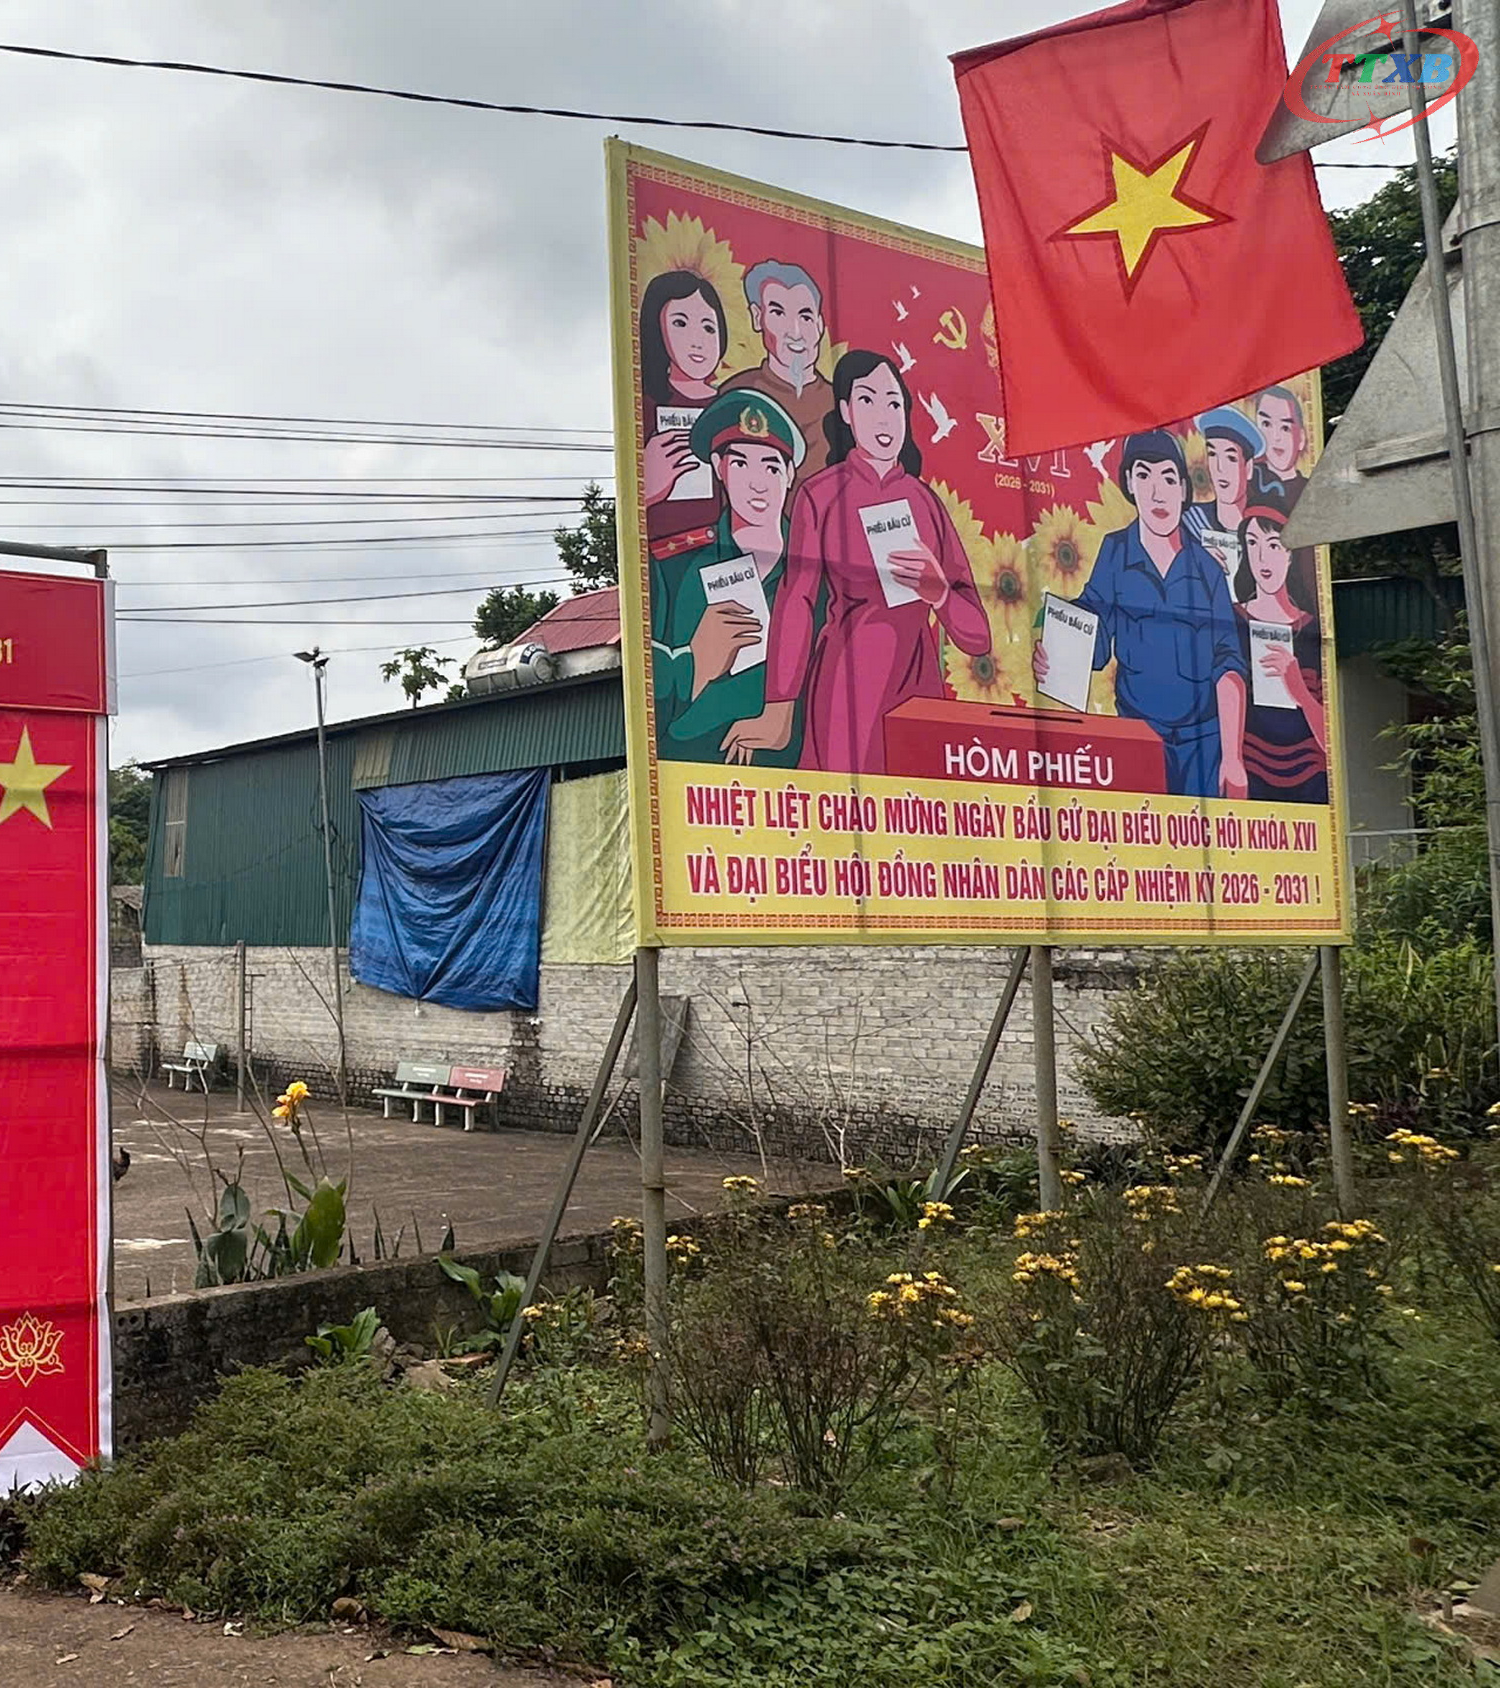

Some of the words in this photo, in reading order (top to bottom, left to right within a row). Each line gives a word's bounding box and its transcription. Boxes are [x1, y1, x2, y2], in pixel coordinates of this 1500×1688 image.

[945, 737, 1019, 779] HÒM
[1027, 744, 1114, 787] PHIẾU
[686, 780, 757, 836] NHIỆT
[764, 783, 812, 838] LIỆT
[818, 787, 878, 833] CHÀO
[884, 791, 948, 836] MỪNG
[953, 795, 1006, 839] NGÀY
[1012, 794, 1052, 842] BẦU
[1057, 797, 1084, 842] CỬ
[1087, 809, 1117, 850] ĐẠI
[1122, 800, 1162, 845] BIỂU
[1167, 804, 1211, 850] QUỐC
[1215, 811, 1243, 856] HỘI
[1248, 813, 1290, 852] KHÓA
[1292, 821, 1318, 852] XVI
[686, 846, 721, 894] VÀ
[727, 856, 768, 903] ĐẠI
[775, 843, 827, 895] BIỂU
[834, 853, 872, 905] HỘI
[878, 849, 937, 898] ĐỒNG
[943, 857, 1000, 899] NHÂN
[1005, 858, 1047, 901] DÂN
[1051, 860, 1089, 901] CÁC
[1094, 856, 1129, 901] CẤP
[1134, 863, 1192, 909] NHIỆM
[1195, 865, 1216, 904] KỲ
[1221, 872, 1260, 905] 2026
[1274, 874, 1310, 905] 2031
[1314, 874, 1322, 905] !
